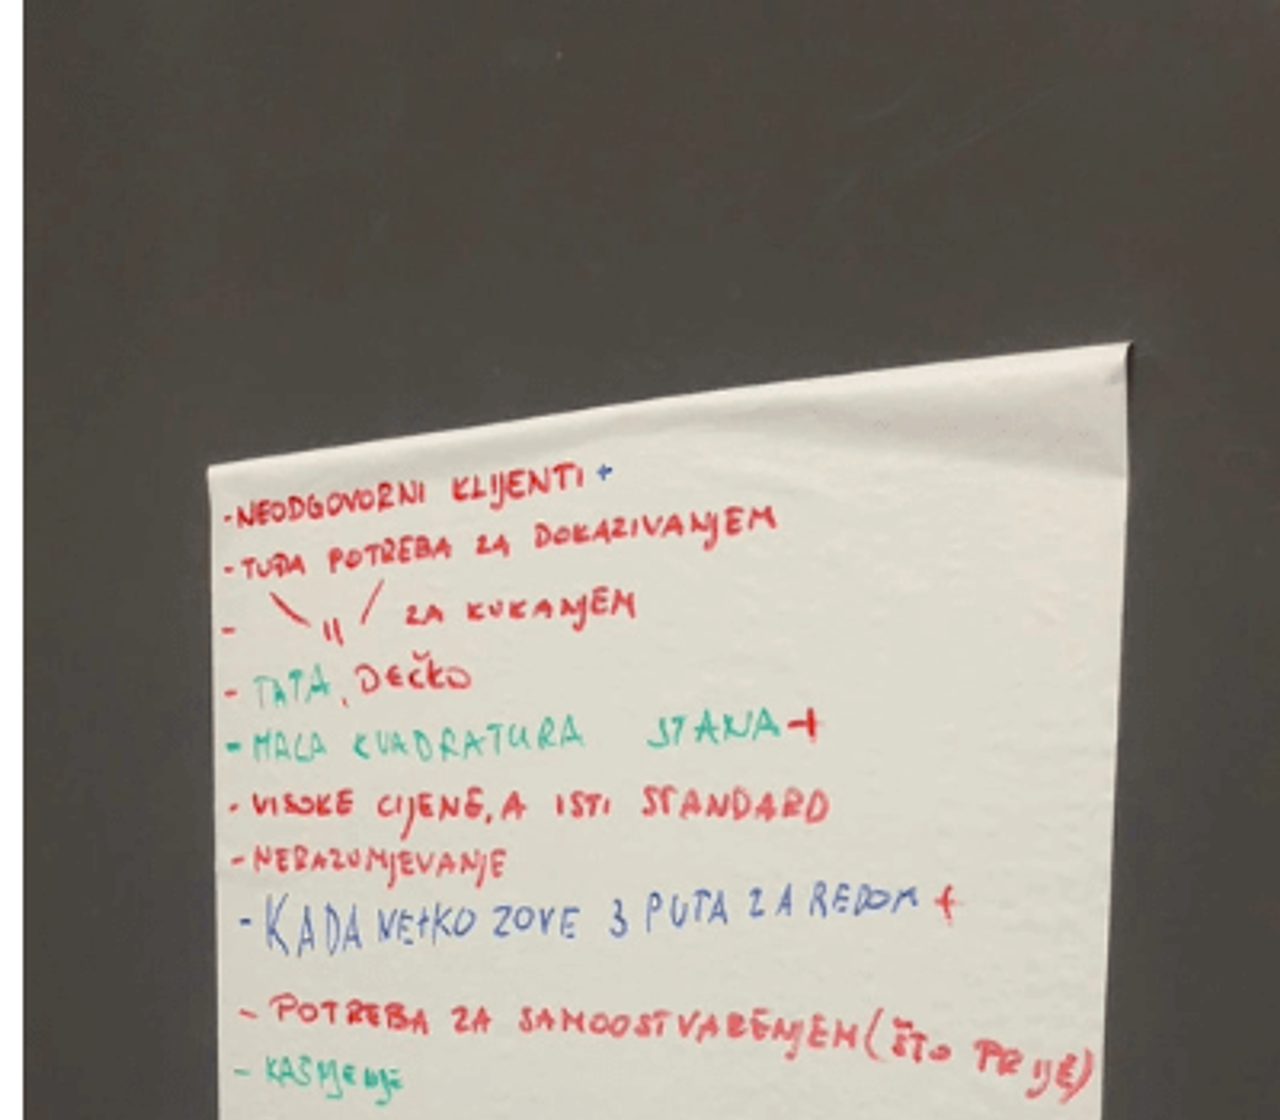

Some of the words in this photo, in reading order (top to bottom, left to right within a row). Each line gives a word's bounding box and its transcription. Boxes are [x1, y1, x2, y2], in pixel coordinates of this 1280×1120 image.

[236, 480, 427, 530] NEODGOVORNI
[451, 461, 584, 511] KLIJENTI
[328, 534, 453, 575] POTREBA
[534, 505, 778, 552] DOKAZIVANJEM
[465, 585, 638, 633] KUKANJEM
[251, 789, 356, 818] VISOKE
[556, 791, 613, 818] ISTI
[641, 784, 831, 825] STANDARD
[264, 892, 363, 958] KADA
[492, 905, 581, 940] ZOVE
[609, 898, 629, 939] 3
[644, 890, 729, 934] PUTA
[268, 992, 429, 1037] POTREBA
